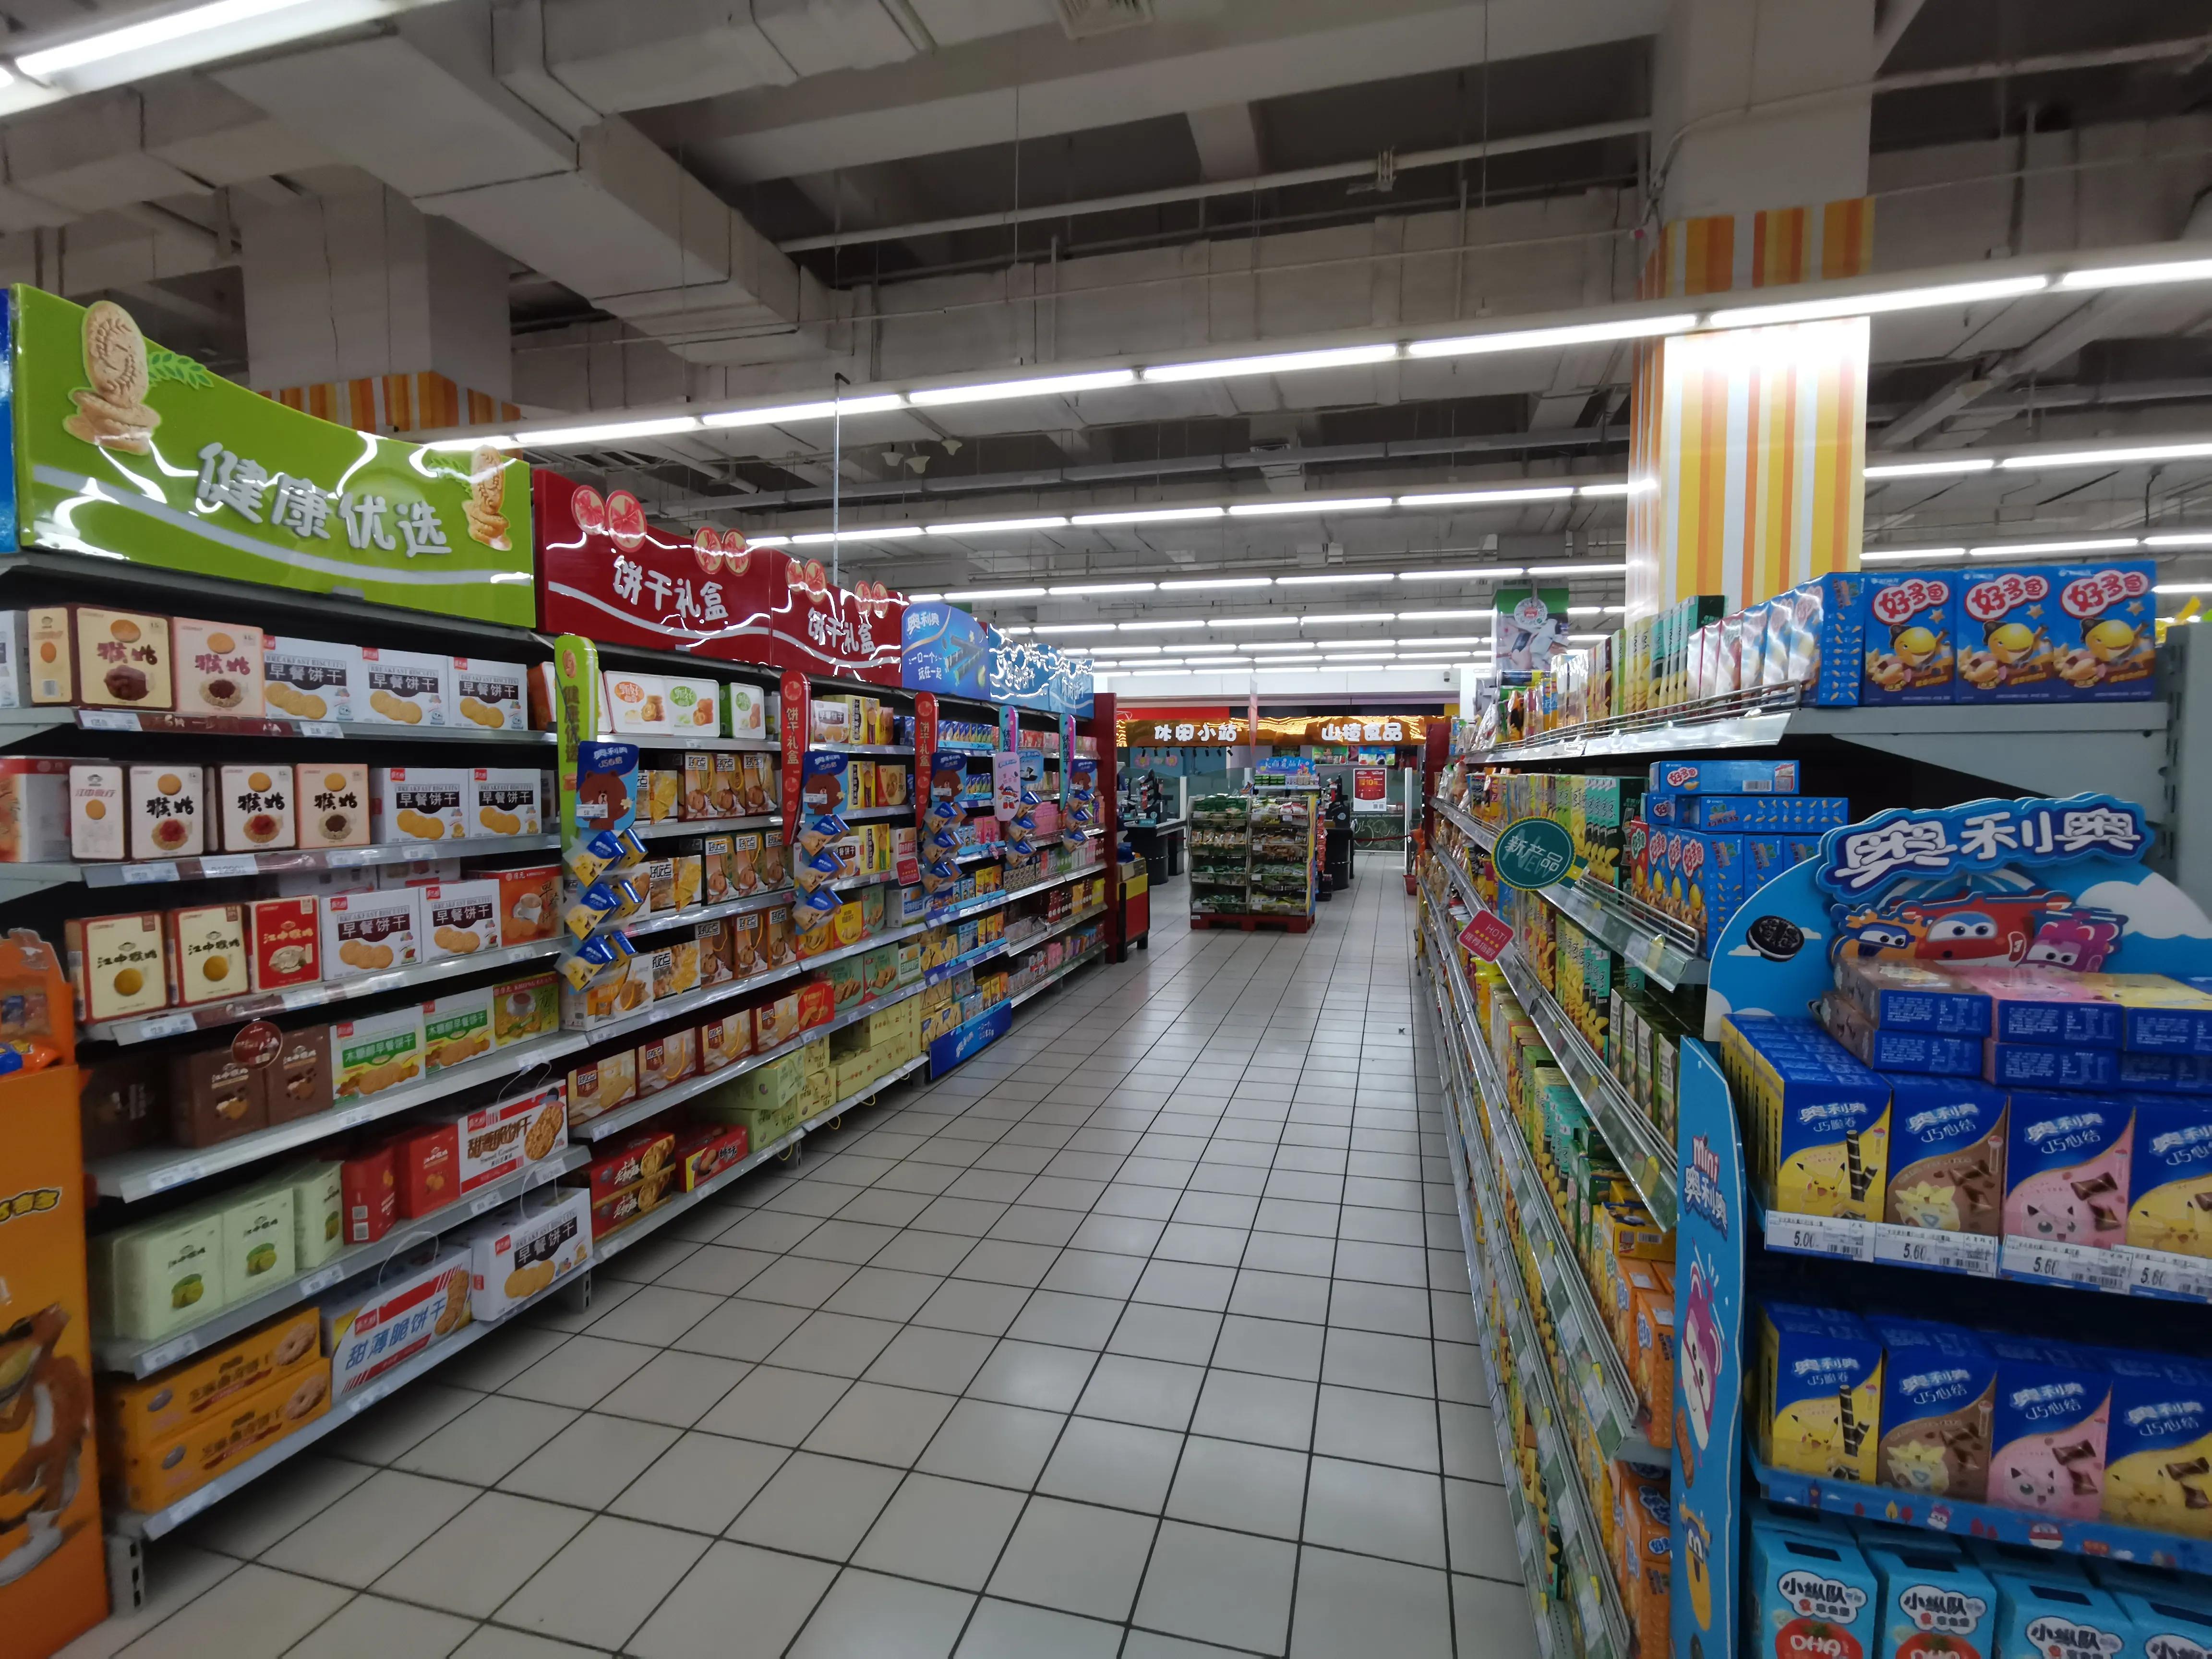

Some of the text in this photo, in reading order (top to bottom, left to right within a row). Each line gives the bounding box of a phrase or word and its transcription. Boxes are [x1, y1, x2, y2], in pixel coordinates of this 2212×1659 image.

[198, 442, 452, 558] 健康优选
[613, 555, 728, 621] 饼干礼盒
[1878, 582, 1944, 619] 好多鱼
[1972, 577, 2043, 615] 好多鱼
[2068, 573, 2143, 612] 好多鱼
[807, 606, 876, 654] 饼干礼盒
[906, 612, 940, 634] 奥利奥
[269, 664, 342, 684] 早餐饼干
[373, 673, 435, 692] 早餐饼干
[463, 682, 516, 698] 早餐饼干
[786, 707, 799, 765] 饼干礼盒
[919, 721, 930, 767] 饼干礼盒
[1154, 723, 1237, 742] 休闲小站
[1321, 722, 1403, 742] 山楂食品
[1669, 769, 1697, 784] 好多鱼
[400, 792, 457, 806] 早餐饼干
[482, 791, 530, 804] 早餐饼干
[1504, 835, 1563, 872] 新产品
[1835, 806, 2141, 888] 奥利奥
[342, 916, 406, 938] 早餐饼干
[436, 905, 490, 924] 早餐饼干
[1485, 924, 1507, 943] HOT!
[1799, 1103, 1866, 1122] 奥利奥
[1907, 1104, 1979, 1132] 奥利奥
[2027, 1112, 2103, 1142] 奥利奥
[2153, 1125, 2212, 1153] 奥利
[2041, 1130, 2101, 1154] 巧心结
[2166, 1141, 2212, 1165] 巧心
[1684, 1166, 1728, 1230] 奥利奥
[518, 1221, 575, 1264] 早餐饼干
[345, 1297, 446, 1371] 甜薄脆饼干
[1790, 1635, 1841, 1657] DHA
